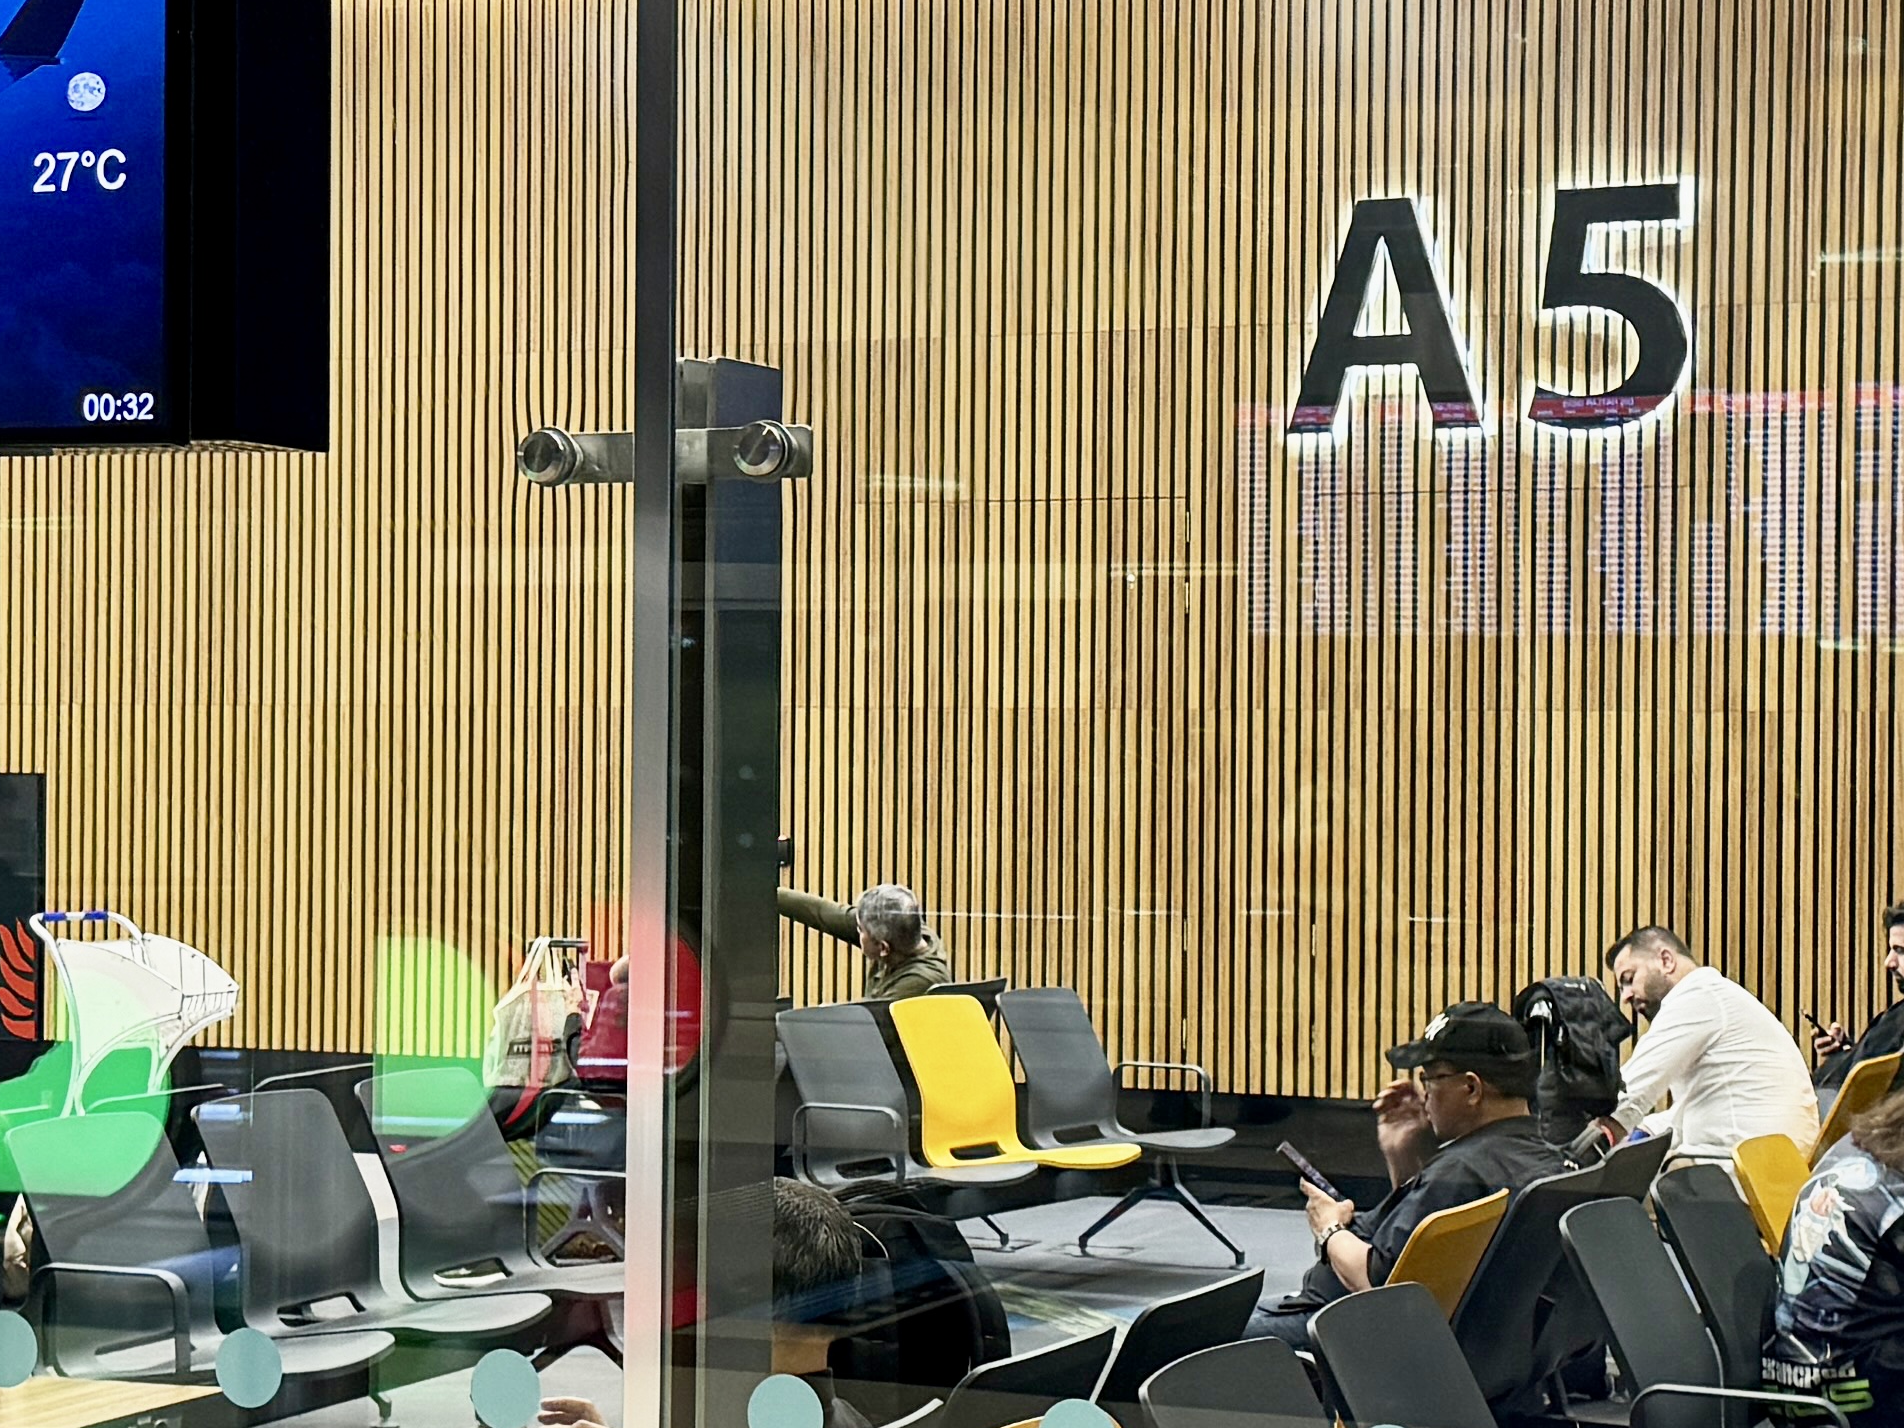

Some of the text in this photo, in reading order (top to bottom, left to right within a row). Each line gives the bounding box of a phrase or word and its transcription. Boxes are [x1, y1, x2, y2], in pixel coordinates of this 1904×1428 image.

[32, 148, 127, 193] 27°C
[1286, 182, 1689, 434] A5
[82, 392, 154, 422] 00:32
